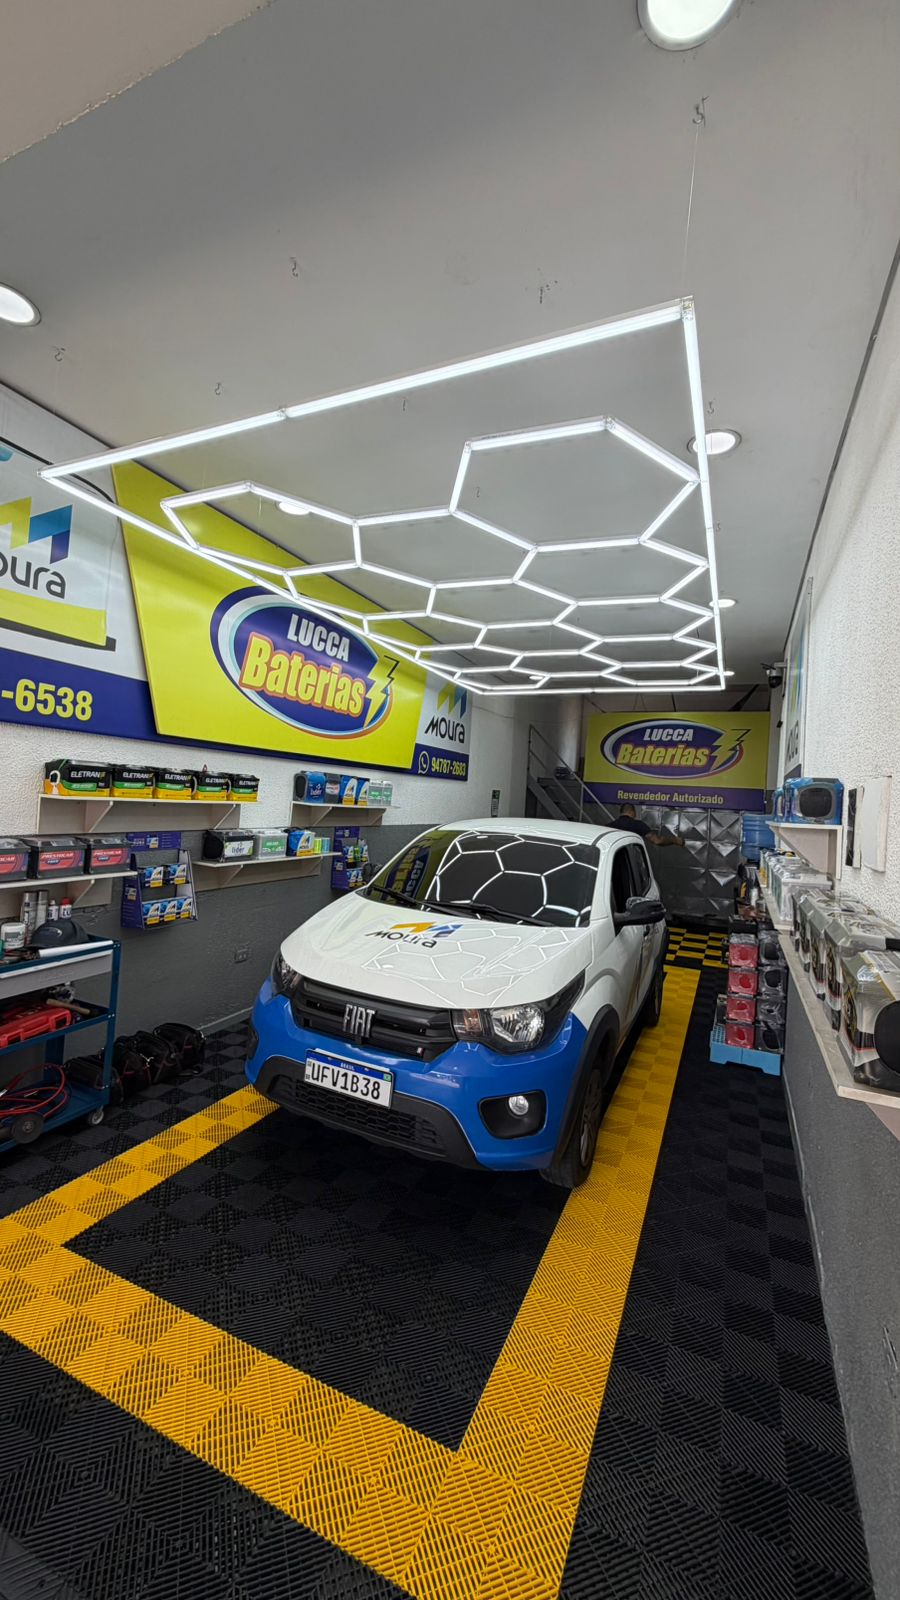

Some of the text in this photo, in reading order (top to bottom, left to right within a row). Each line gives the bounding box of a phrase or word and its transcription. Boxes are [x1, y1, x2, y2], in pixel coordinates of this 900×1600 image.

[286, 613, 351, 663] LUCCA
[240, 633, 365, 717] Baterias
[643, 728, 694, 742] LUCCA
[431, 756, 467, 777] 94787-2683
[615, 743, 711, 767] Baterias
[617, 790, 724, 804] Revendedor Autorizado
[342, 1003, 376, 1038] FIAT
[310, 1062, 381, 1100] UFV1B38
